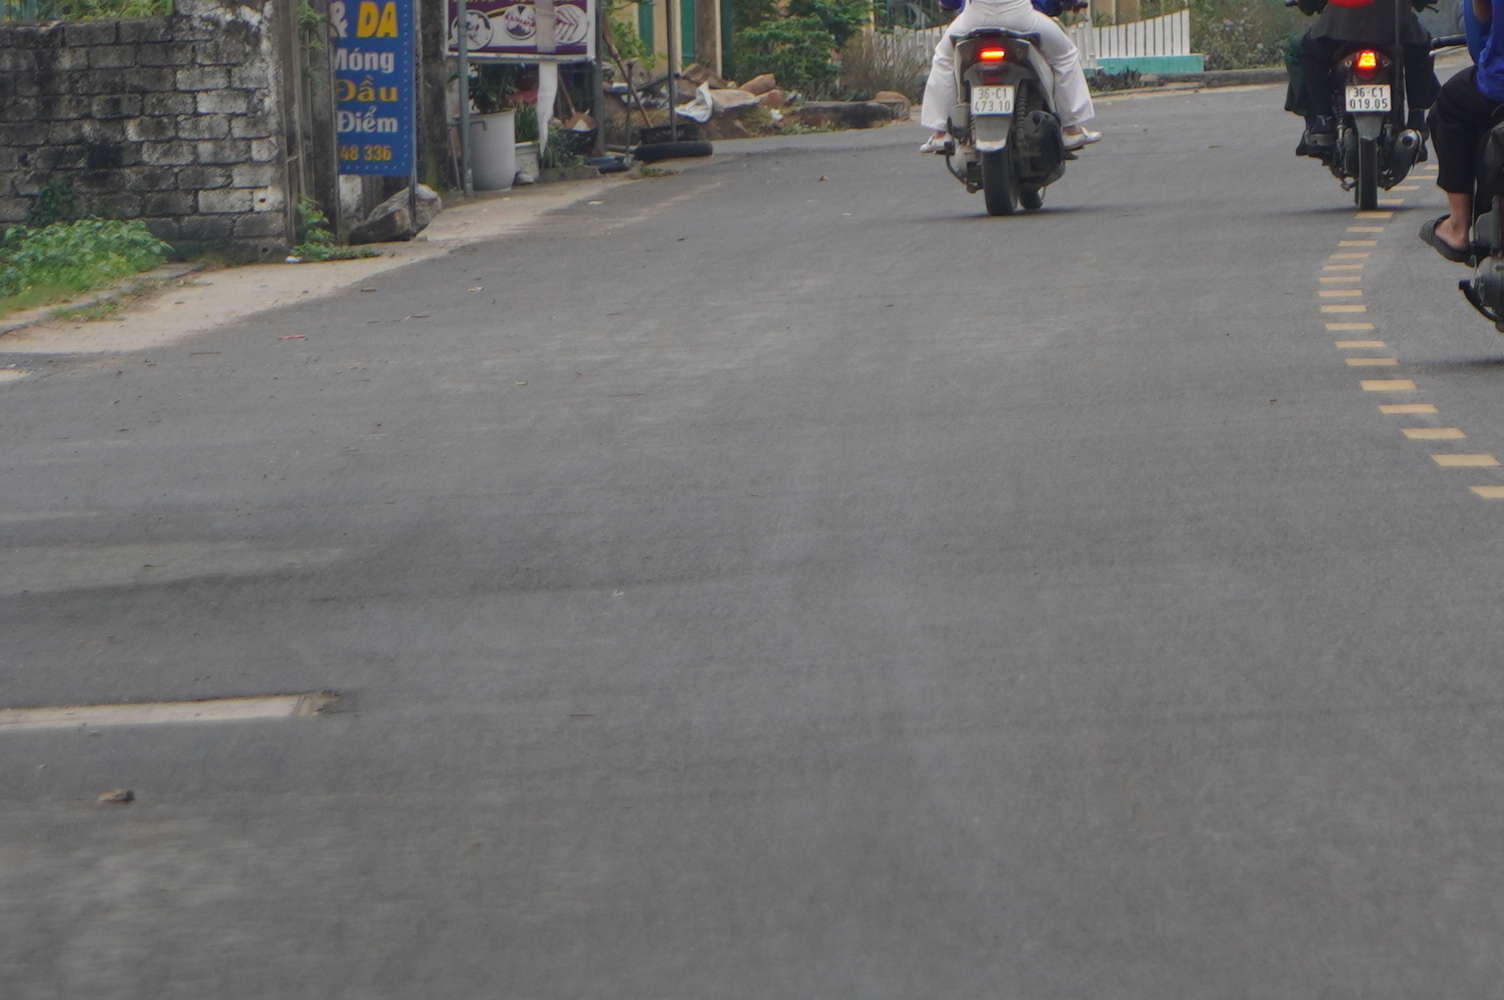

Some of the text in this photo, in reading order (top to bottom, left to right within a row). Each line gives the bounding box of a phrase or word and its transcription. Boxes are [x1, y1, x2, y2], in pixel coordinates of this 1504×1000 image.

[357, 0, 398, 38] DA
[978, 87, 1007, 100] 36-C1
[1353, 87, 1385, 98] 36-C1
[974, 101, 1011, 113] 473.10
[1349, 98, 1388, 109] 019.05
[337, 105, 398, 133] Điểm
[364, 145, 392, 162] 336
